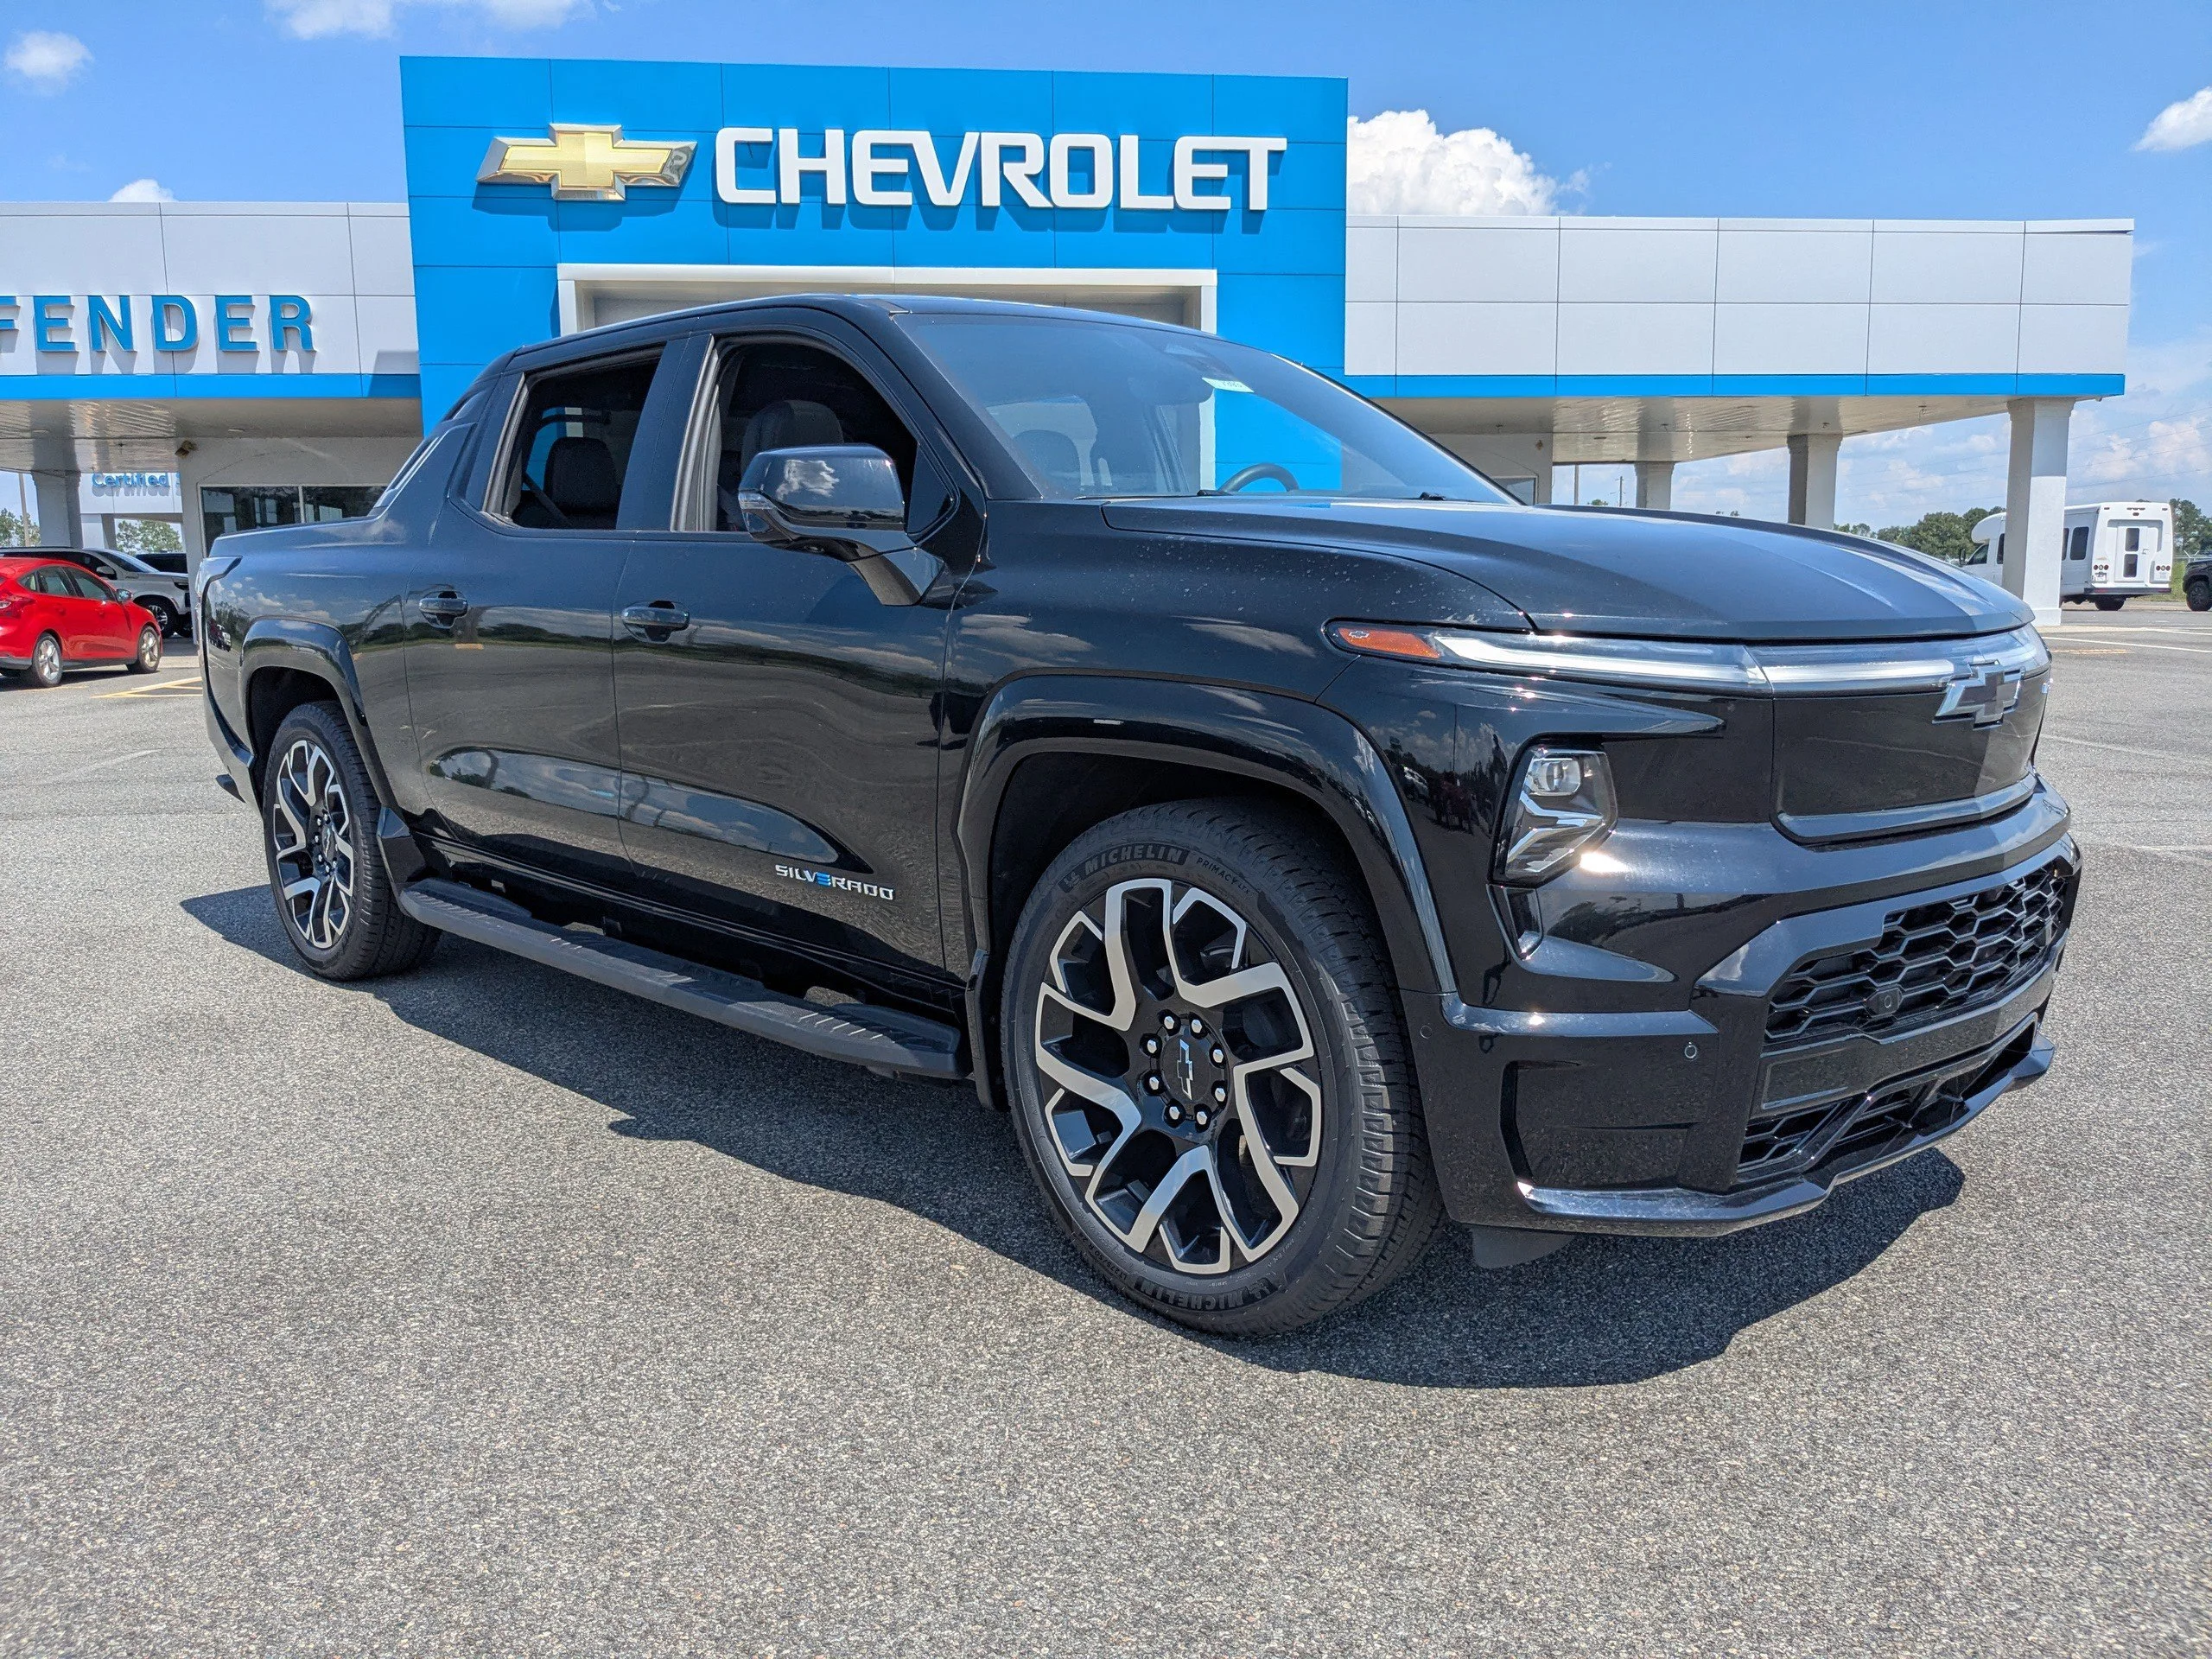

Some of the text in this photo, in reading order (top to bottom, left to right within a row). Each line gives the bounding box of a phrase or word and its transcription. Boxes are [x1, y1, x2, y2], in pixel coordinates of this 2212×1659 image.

[715, 127, 1287, 211] CHEVROLET
[92, 472, 169, 487] Certified
[1085, 845, 1182, 874] MICHELIN
[1197, 857, 1239, 885] PRIMACY
[775, 864, 895, 900] SILVERADO
[1141, 1279, 1243, 1310] MICHELIN
